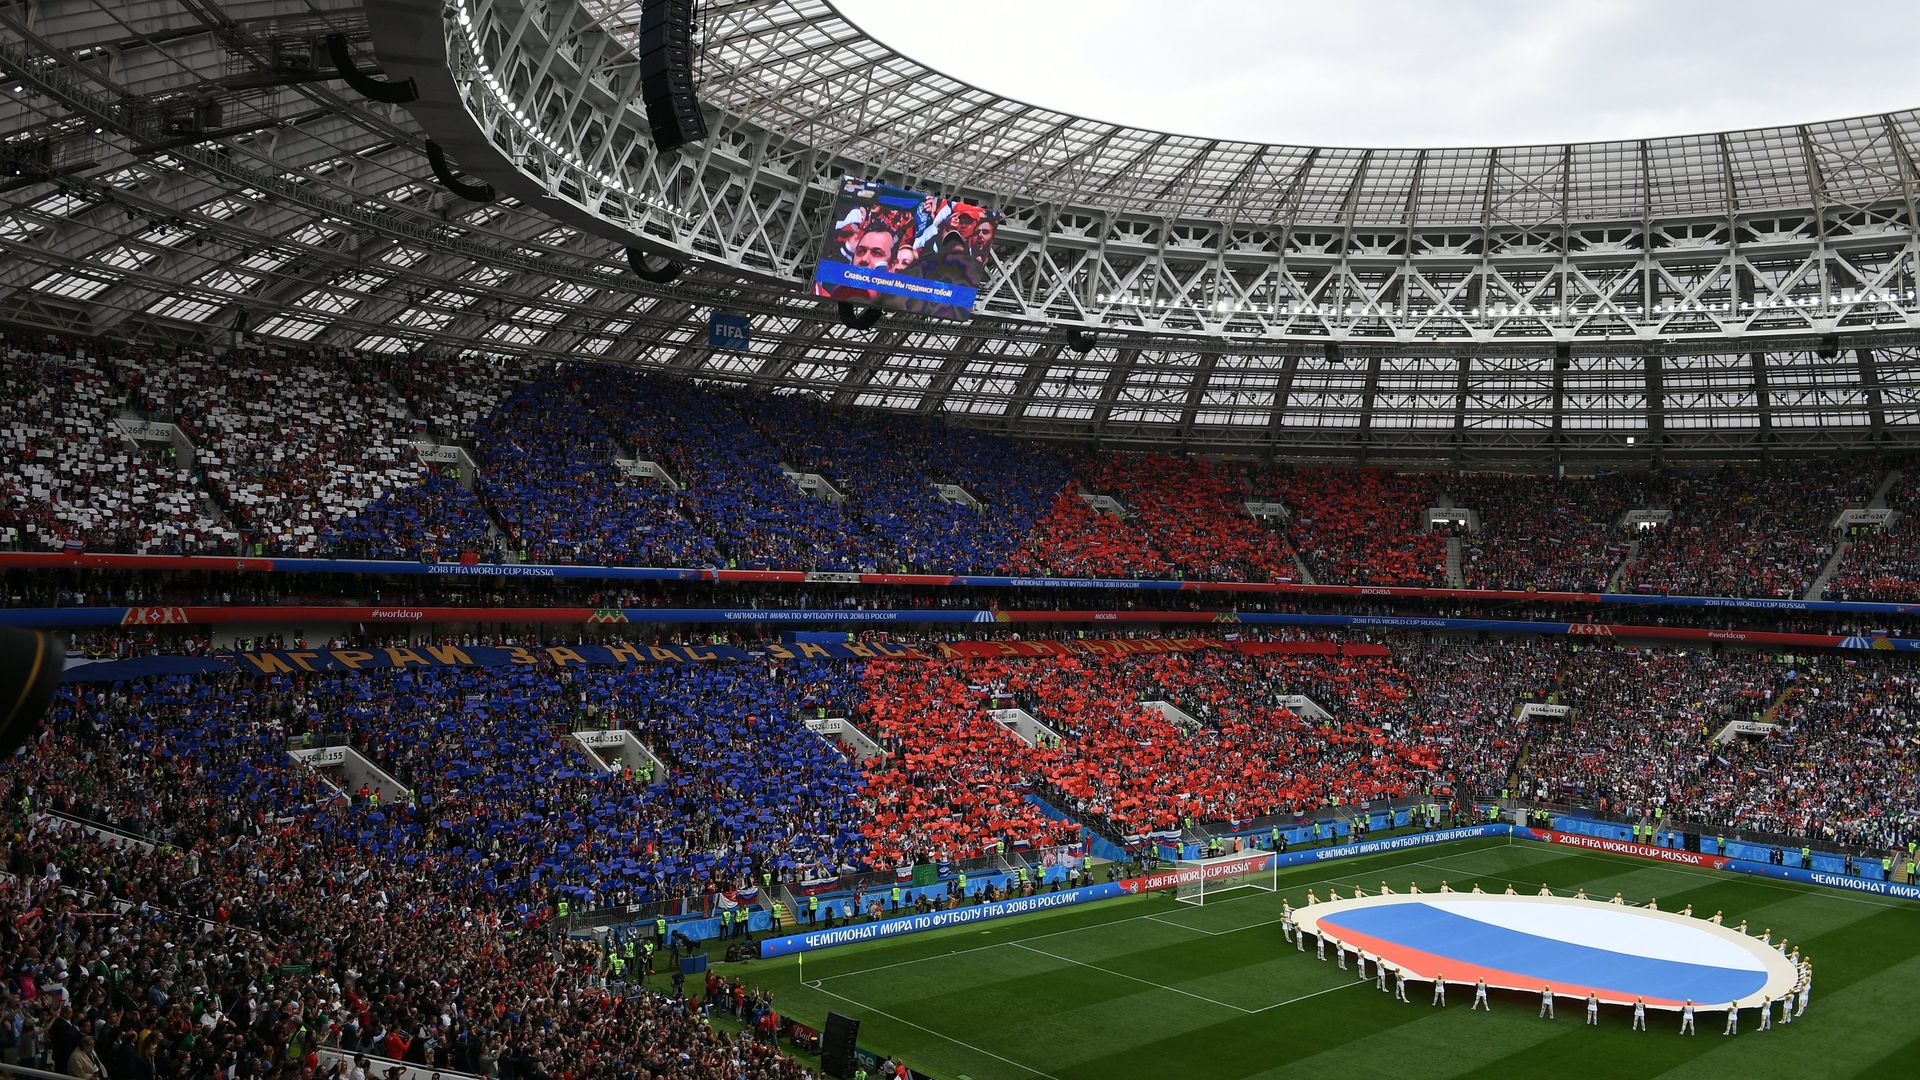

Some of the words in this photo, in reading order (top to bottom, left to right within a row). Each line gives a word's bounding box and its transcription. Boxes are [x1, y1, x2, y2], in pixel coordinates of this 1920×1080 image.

[894, 280, 904, 289] Мы
[716, 324, 744, 338] FIFA
[128, 426, 143, 434] 266
[428, 566, 448, 574] 2018
[450, 566, 469, 574] FIFA
[470, 567, 502, 575] WORLD
[523, 568, 555, 576] RUSSIA
[372, 609, 422, 620] #worldcup
[496, 645, 587, 666] ЗА
[302, 754, 317, 762] 156
[328, 752, 342, 760] 155
[1316, 845, 1358, 860] ЧЕМПИОНАТ
[1360, 842, 1380, 854] МИРА
[1381, 841, 1390, 850] ПО
[1392, 836, 1420, 848] ФУТБОЛУ
[1422, 834, 1434, 844] FIFA
[1436, 832, 1450, 842] 2018
[1560, 834, 1580, 844] 2018
[1582, 838, 1601, 848] FIFA
[1602, 841, 1638, 854] WORLD
[1639, 846, 1660, 857] CUP
[1144, 878, 1162, 888] 2018
[1163, 874, 1180, 885] FIFA
[1180, 869, 1206, 882] WORLD
[1208, 866, 1222, 878] CUP
[1811, 873, 1886, 892] ЧЕМПИОНАТ
[1890, 886, 1920, 898] МИР
[806, 925, 878, 946] ЧЕМПИОНАТ
[880, 920, 912, 935] МИРА
[916, 916, 930, 929] ПО
[934, 908, 980, 925] ФУТБОЛУ
[984, 904, 1004, 916] FIFA
[1006, 901, 1028, 914] 2018
[1030, 899, 1036, 909] В
[793, 1024, 812, 1041] Bud
